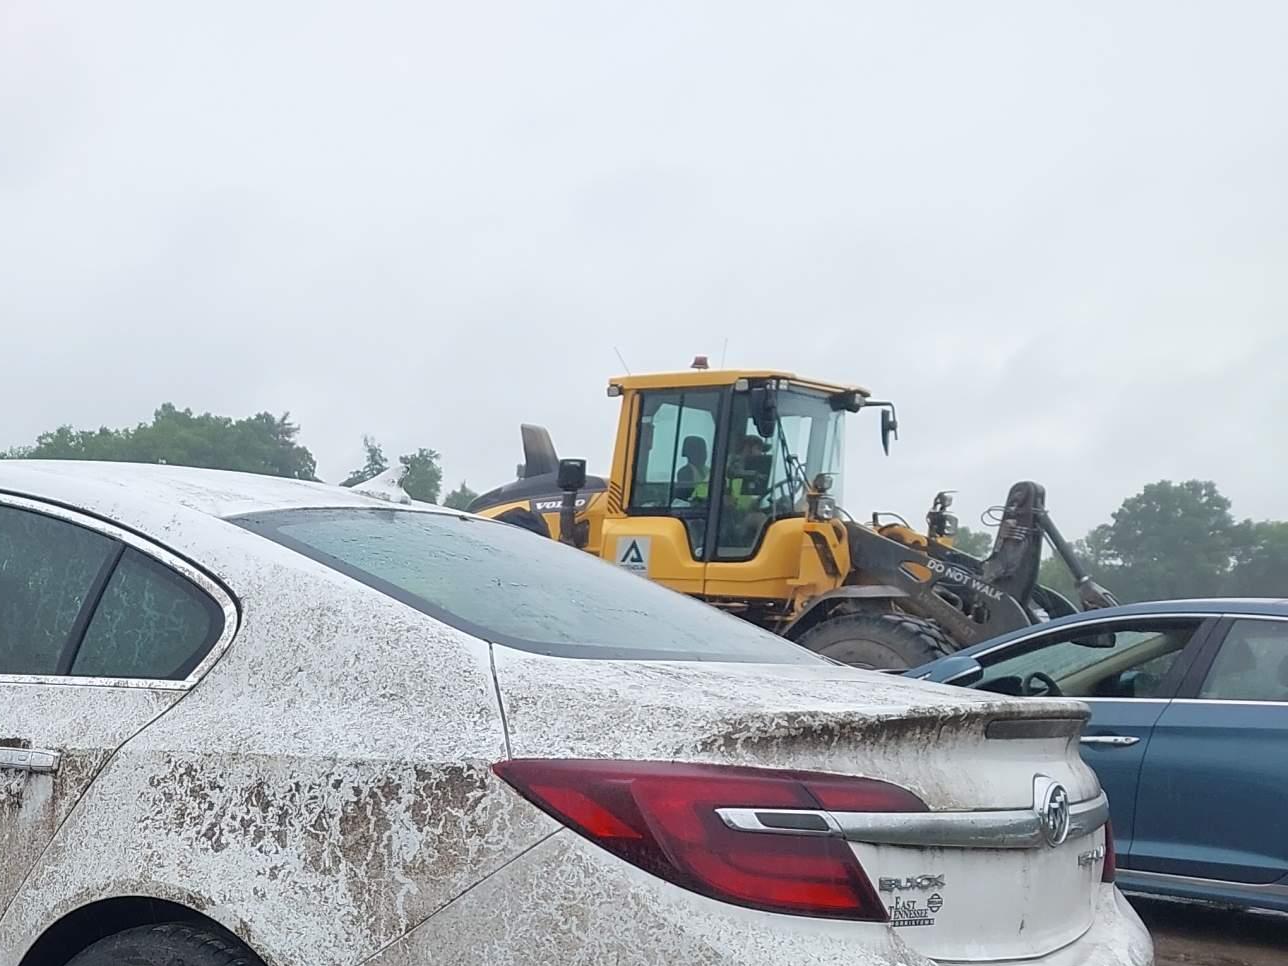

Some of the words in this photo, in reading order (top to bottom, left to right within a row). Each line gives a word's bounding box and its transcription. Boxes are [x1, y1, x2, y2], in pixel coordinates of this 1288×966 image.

[535, 499, 586, 510] VOLO
[927, 560, 945, 573] DO
[945, 567, 971, 585] NOT
[972, 579, 1004, 600] WALK
[878, 874, 946, 892] BUICK
[894, 895, 918, 911] EAST
[888, 905, 929, 920] TENNESSEE
